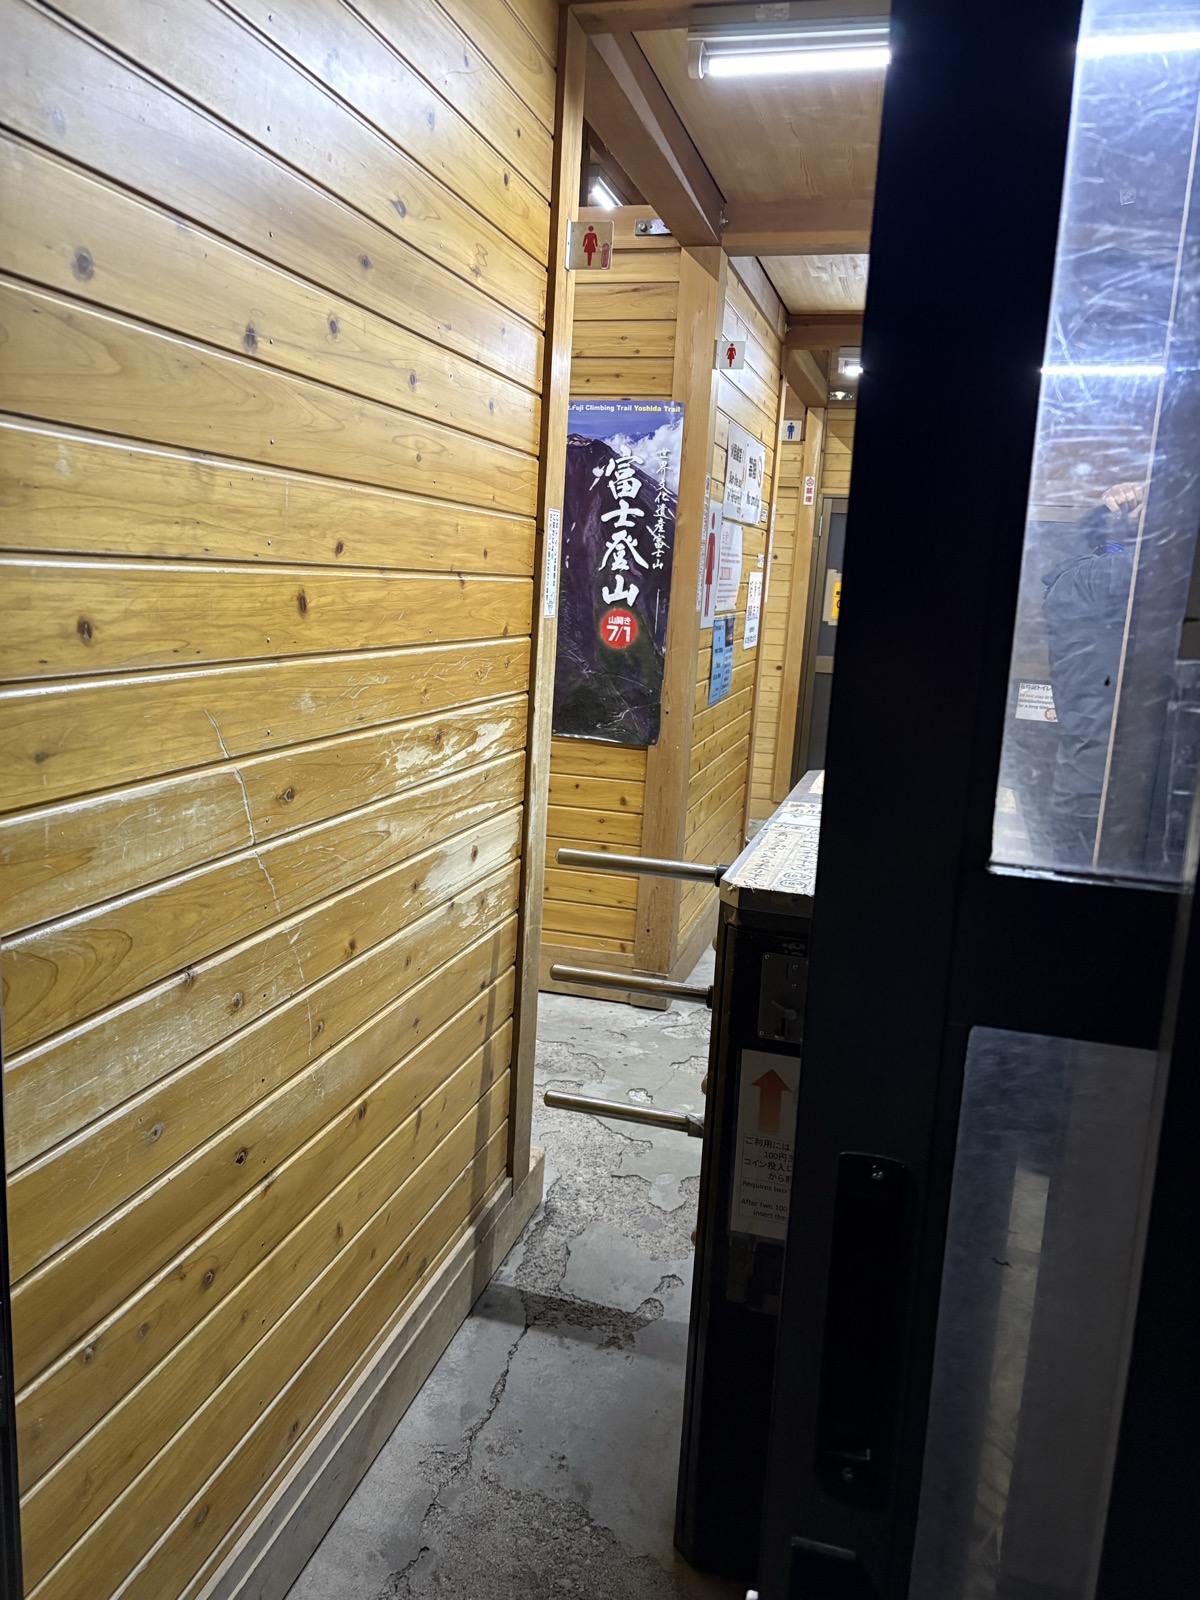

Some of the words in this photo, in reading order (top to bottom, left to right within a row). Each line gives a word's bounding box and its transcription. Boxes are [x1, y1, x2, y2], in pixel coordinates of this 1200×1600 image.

[585, 404, 615, 413] Climbing
[616, 404, 632, 412] Trail
[634, 404, 662, 412] Yoshida
[664, 405, 681, 413] Trail
[651, 448, 673, 570] 世界文化遺産富士山
[598, 445, 650, 607] 富士登山
[608, 616, 632, 626] 山開き
[606, 625, 631, 643] 7/1
[745, 1136, 791, 1151] ご利用には
[742, 1180, 772, 1191] Requires
[773, 1186, 787, 1194] two
[741, 1198, 758, 1208] After
[759, 1202, 773, 1210] two
[775, 1204, 788, 1213] 100
[753, 1209, 773, 1220] insert
